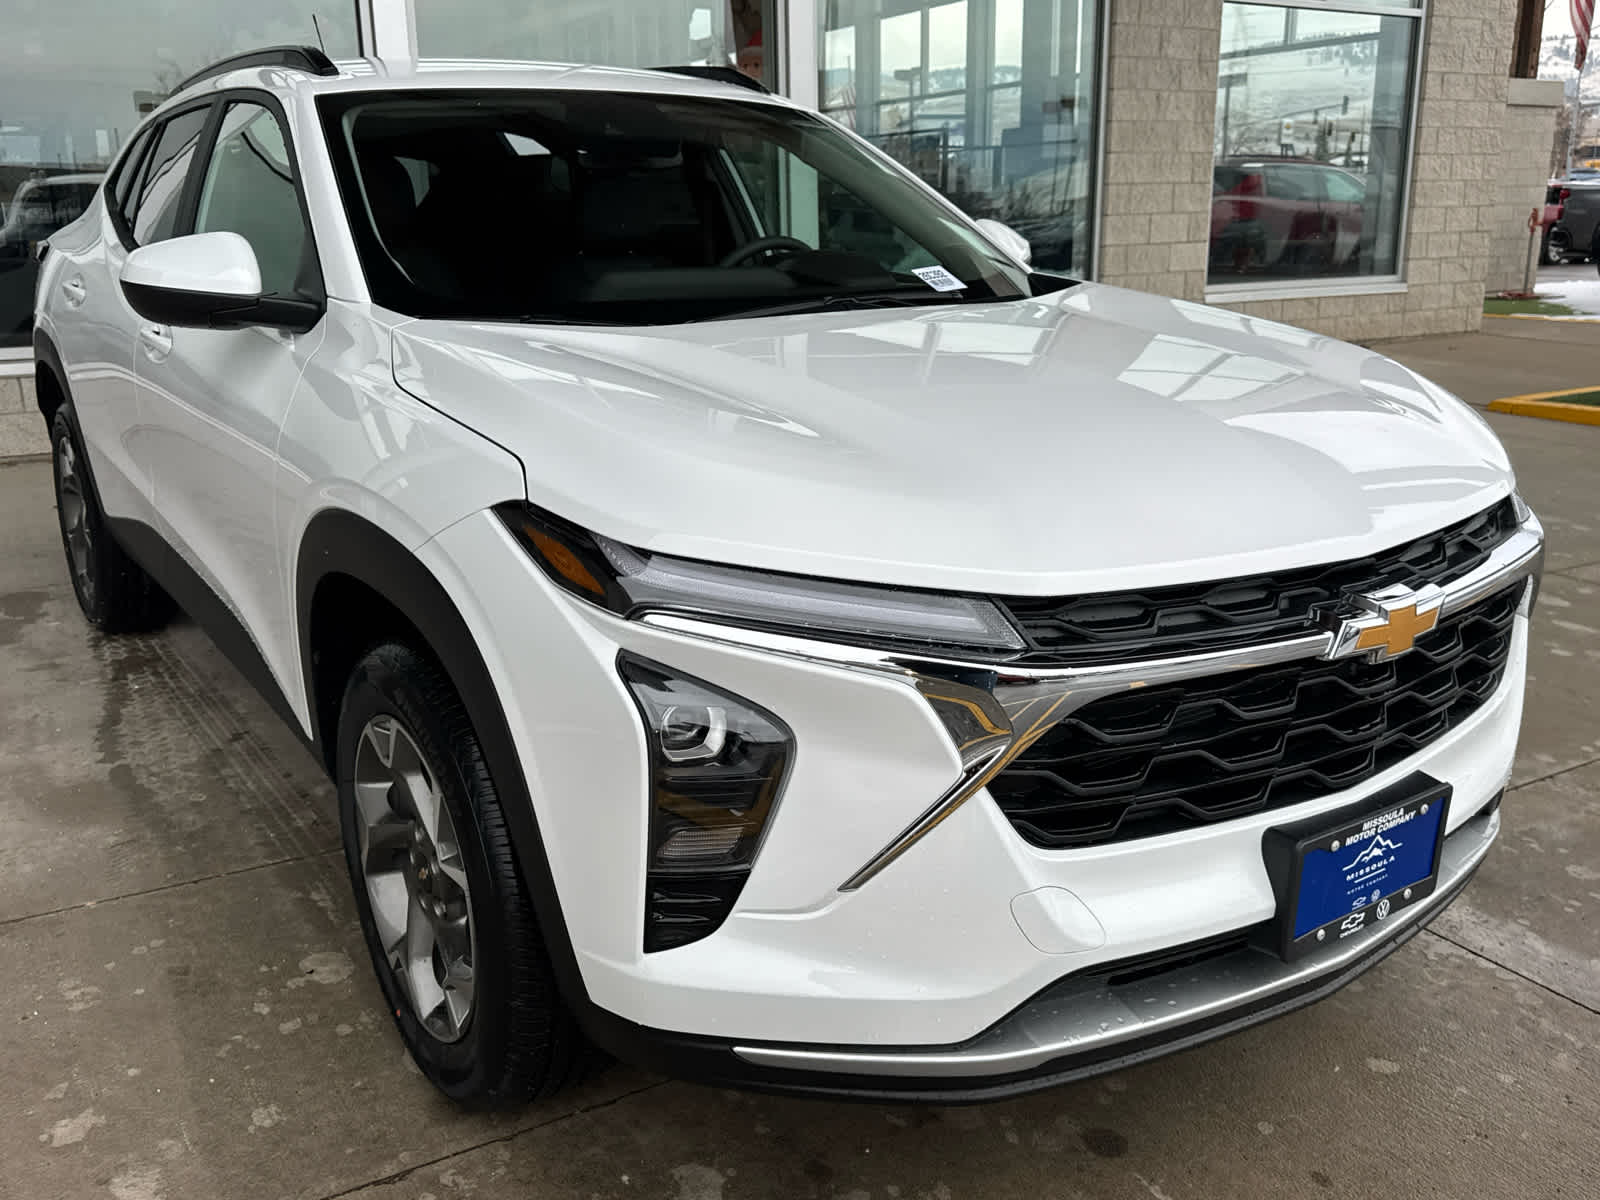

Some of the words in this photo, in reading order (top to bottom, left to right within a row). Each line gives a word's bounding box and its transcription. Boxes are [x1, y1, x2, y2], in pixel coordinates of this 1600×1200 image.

[1345, 828, 1377, 847] MOTOR
[1377, 810, 1417, 833] COMPANY
[1362, 807, 1404, 831] MISSOULA
[1346, 855, 1396, 881] MISSOULA
